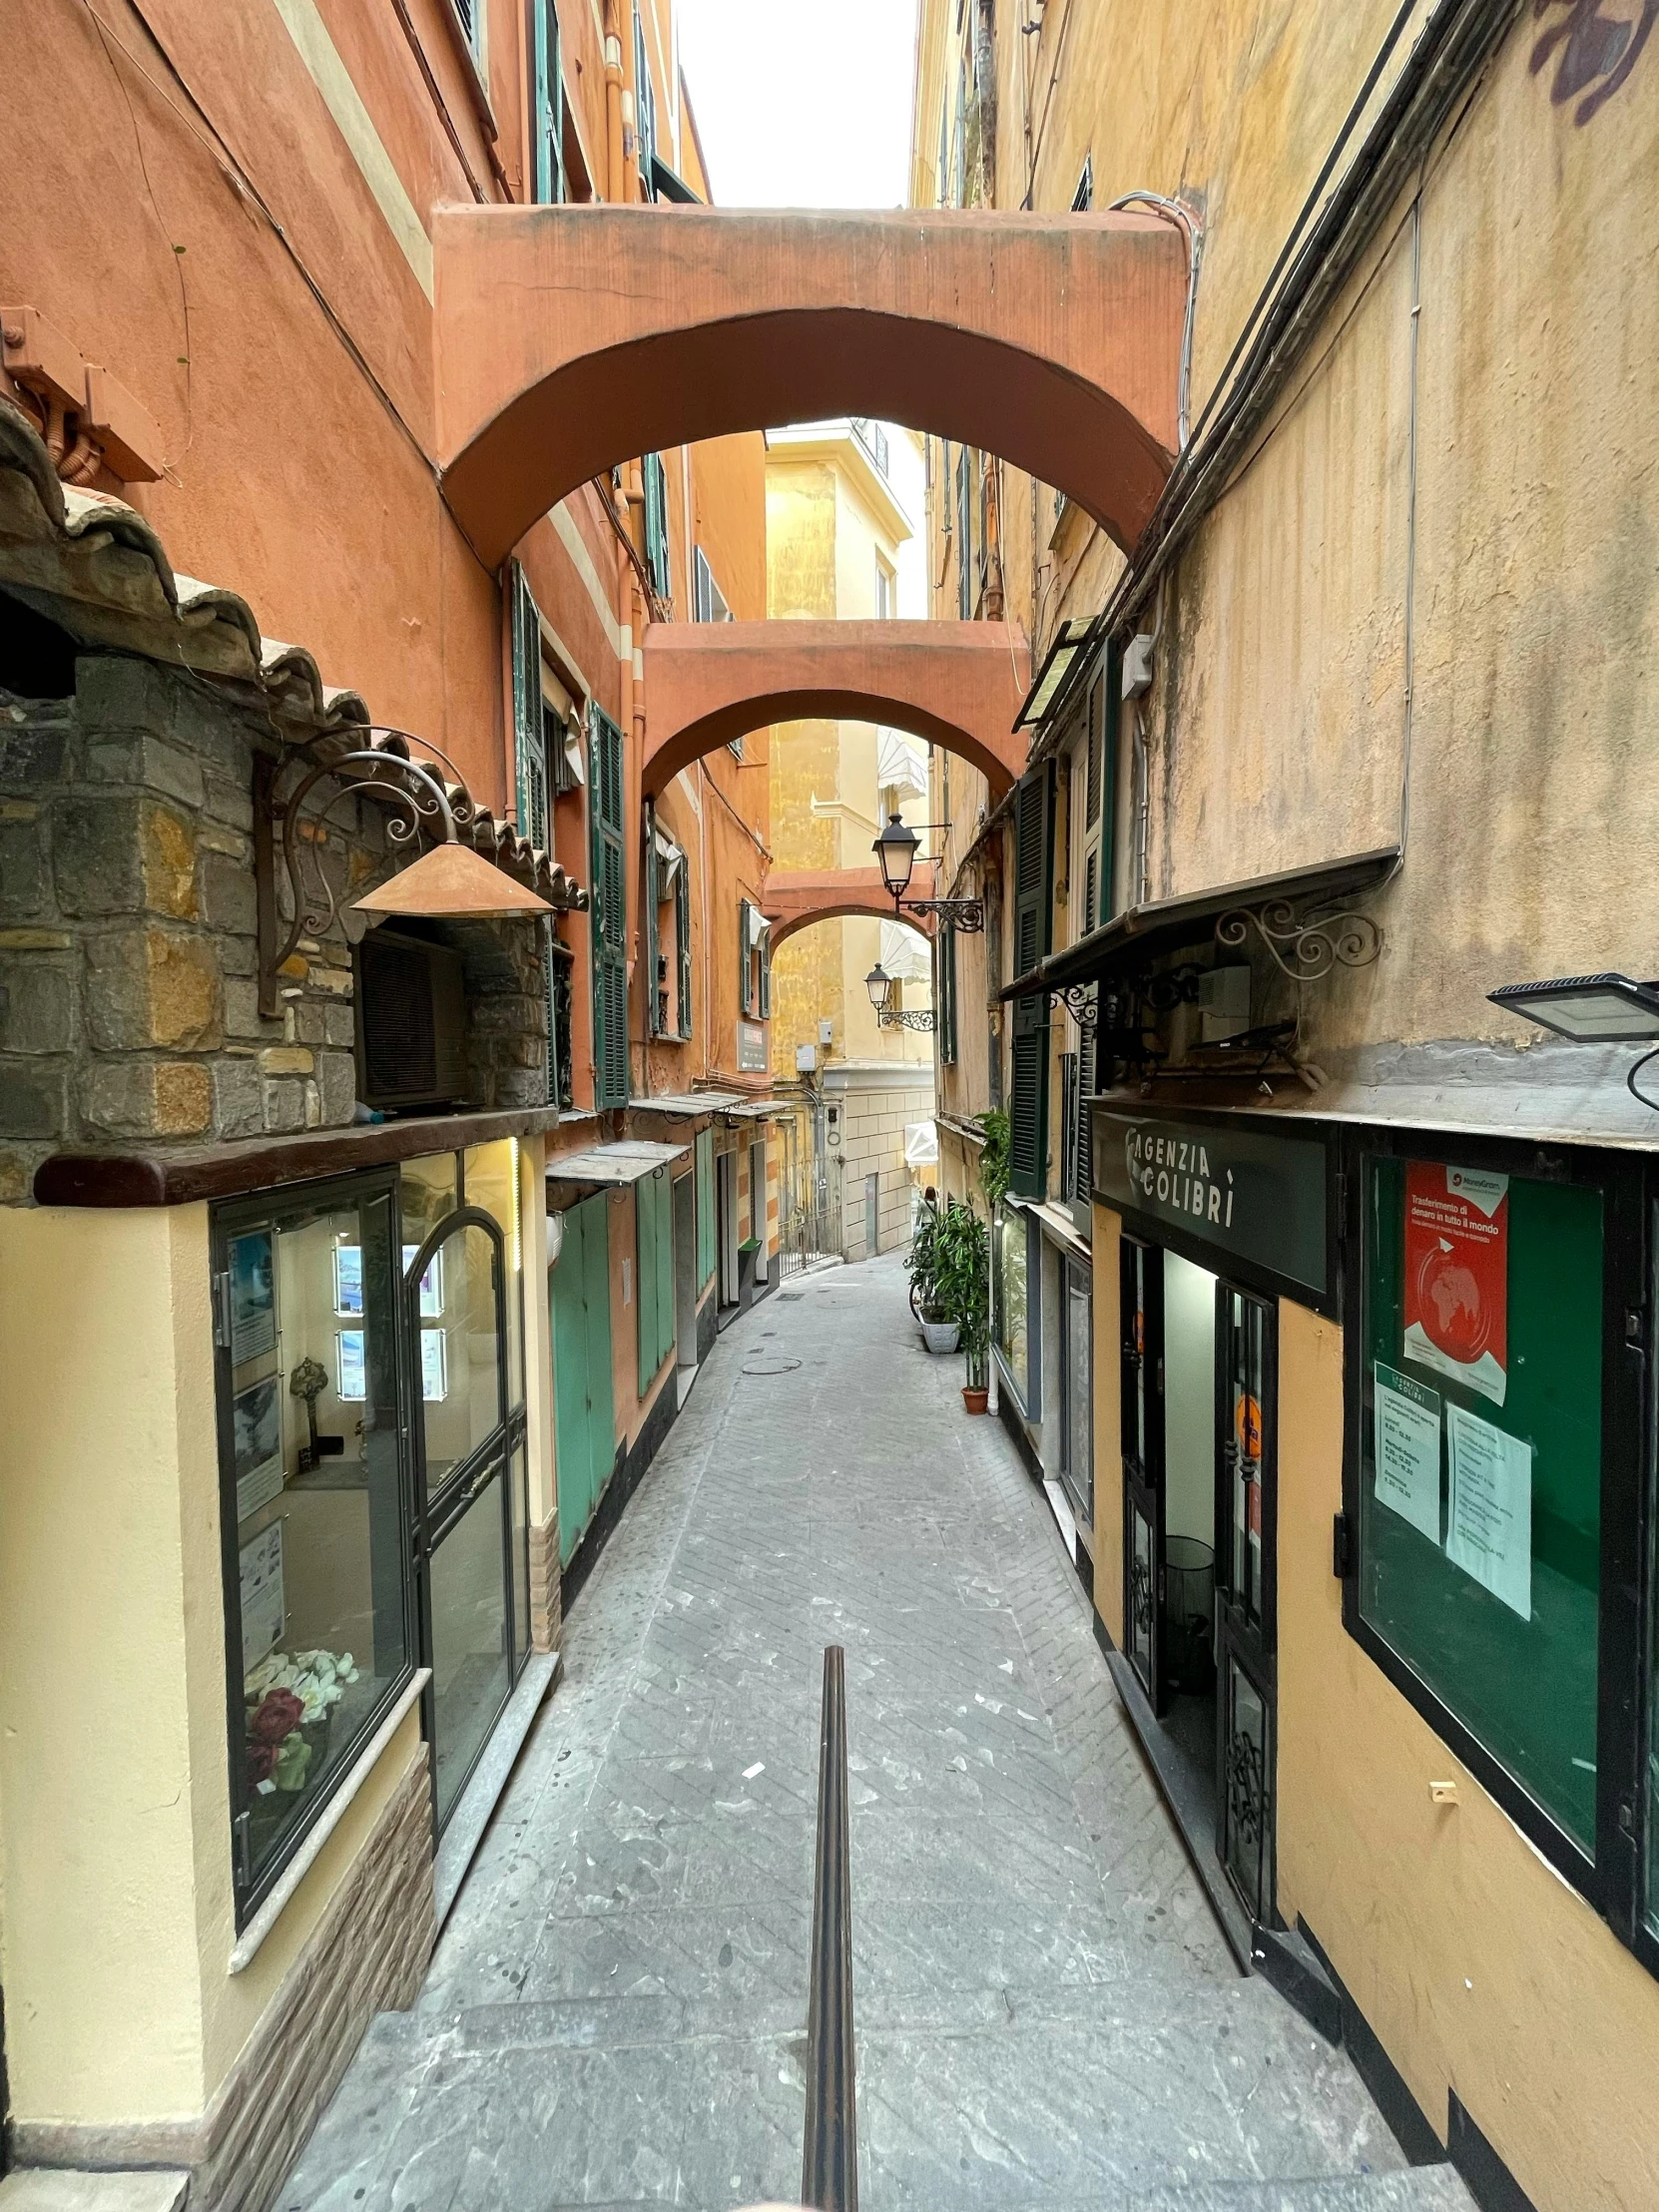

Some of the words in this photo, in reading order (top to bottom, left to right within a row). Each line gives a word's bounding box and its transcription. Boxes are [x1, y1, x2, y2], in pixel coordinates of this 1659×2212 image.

[1134, 1134, 1210, 1178] AGENZIA
[1463, 1177, 1501, 1190] MoneyGram
[1411, 1195, 1458, 1215] Trasferimento
[1459, 1205, 1468, 1216] di
[1410, 1207, 1435, 1220] denaro
[1436, 1211, 1443, 1222] in
[1444, 1214, 1461, 1227] tutto
[1462, 1218, 1468, 1228] il
[1469, 1221, 1499, 1236] mondo
